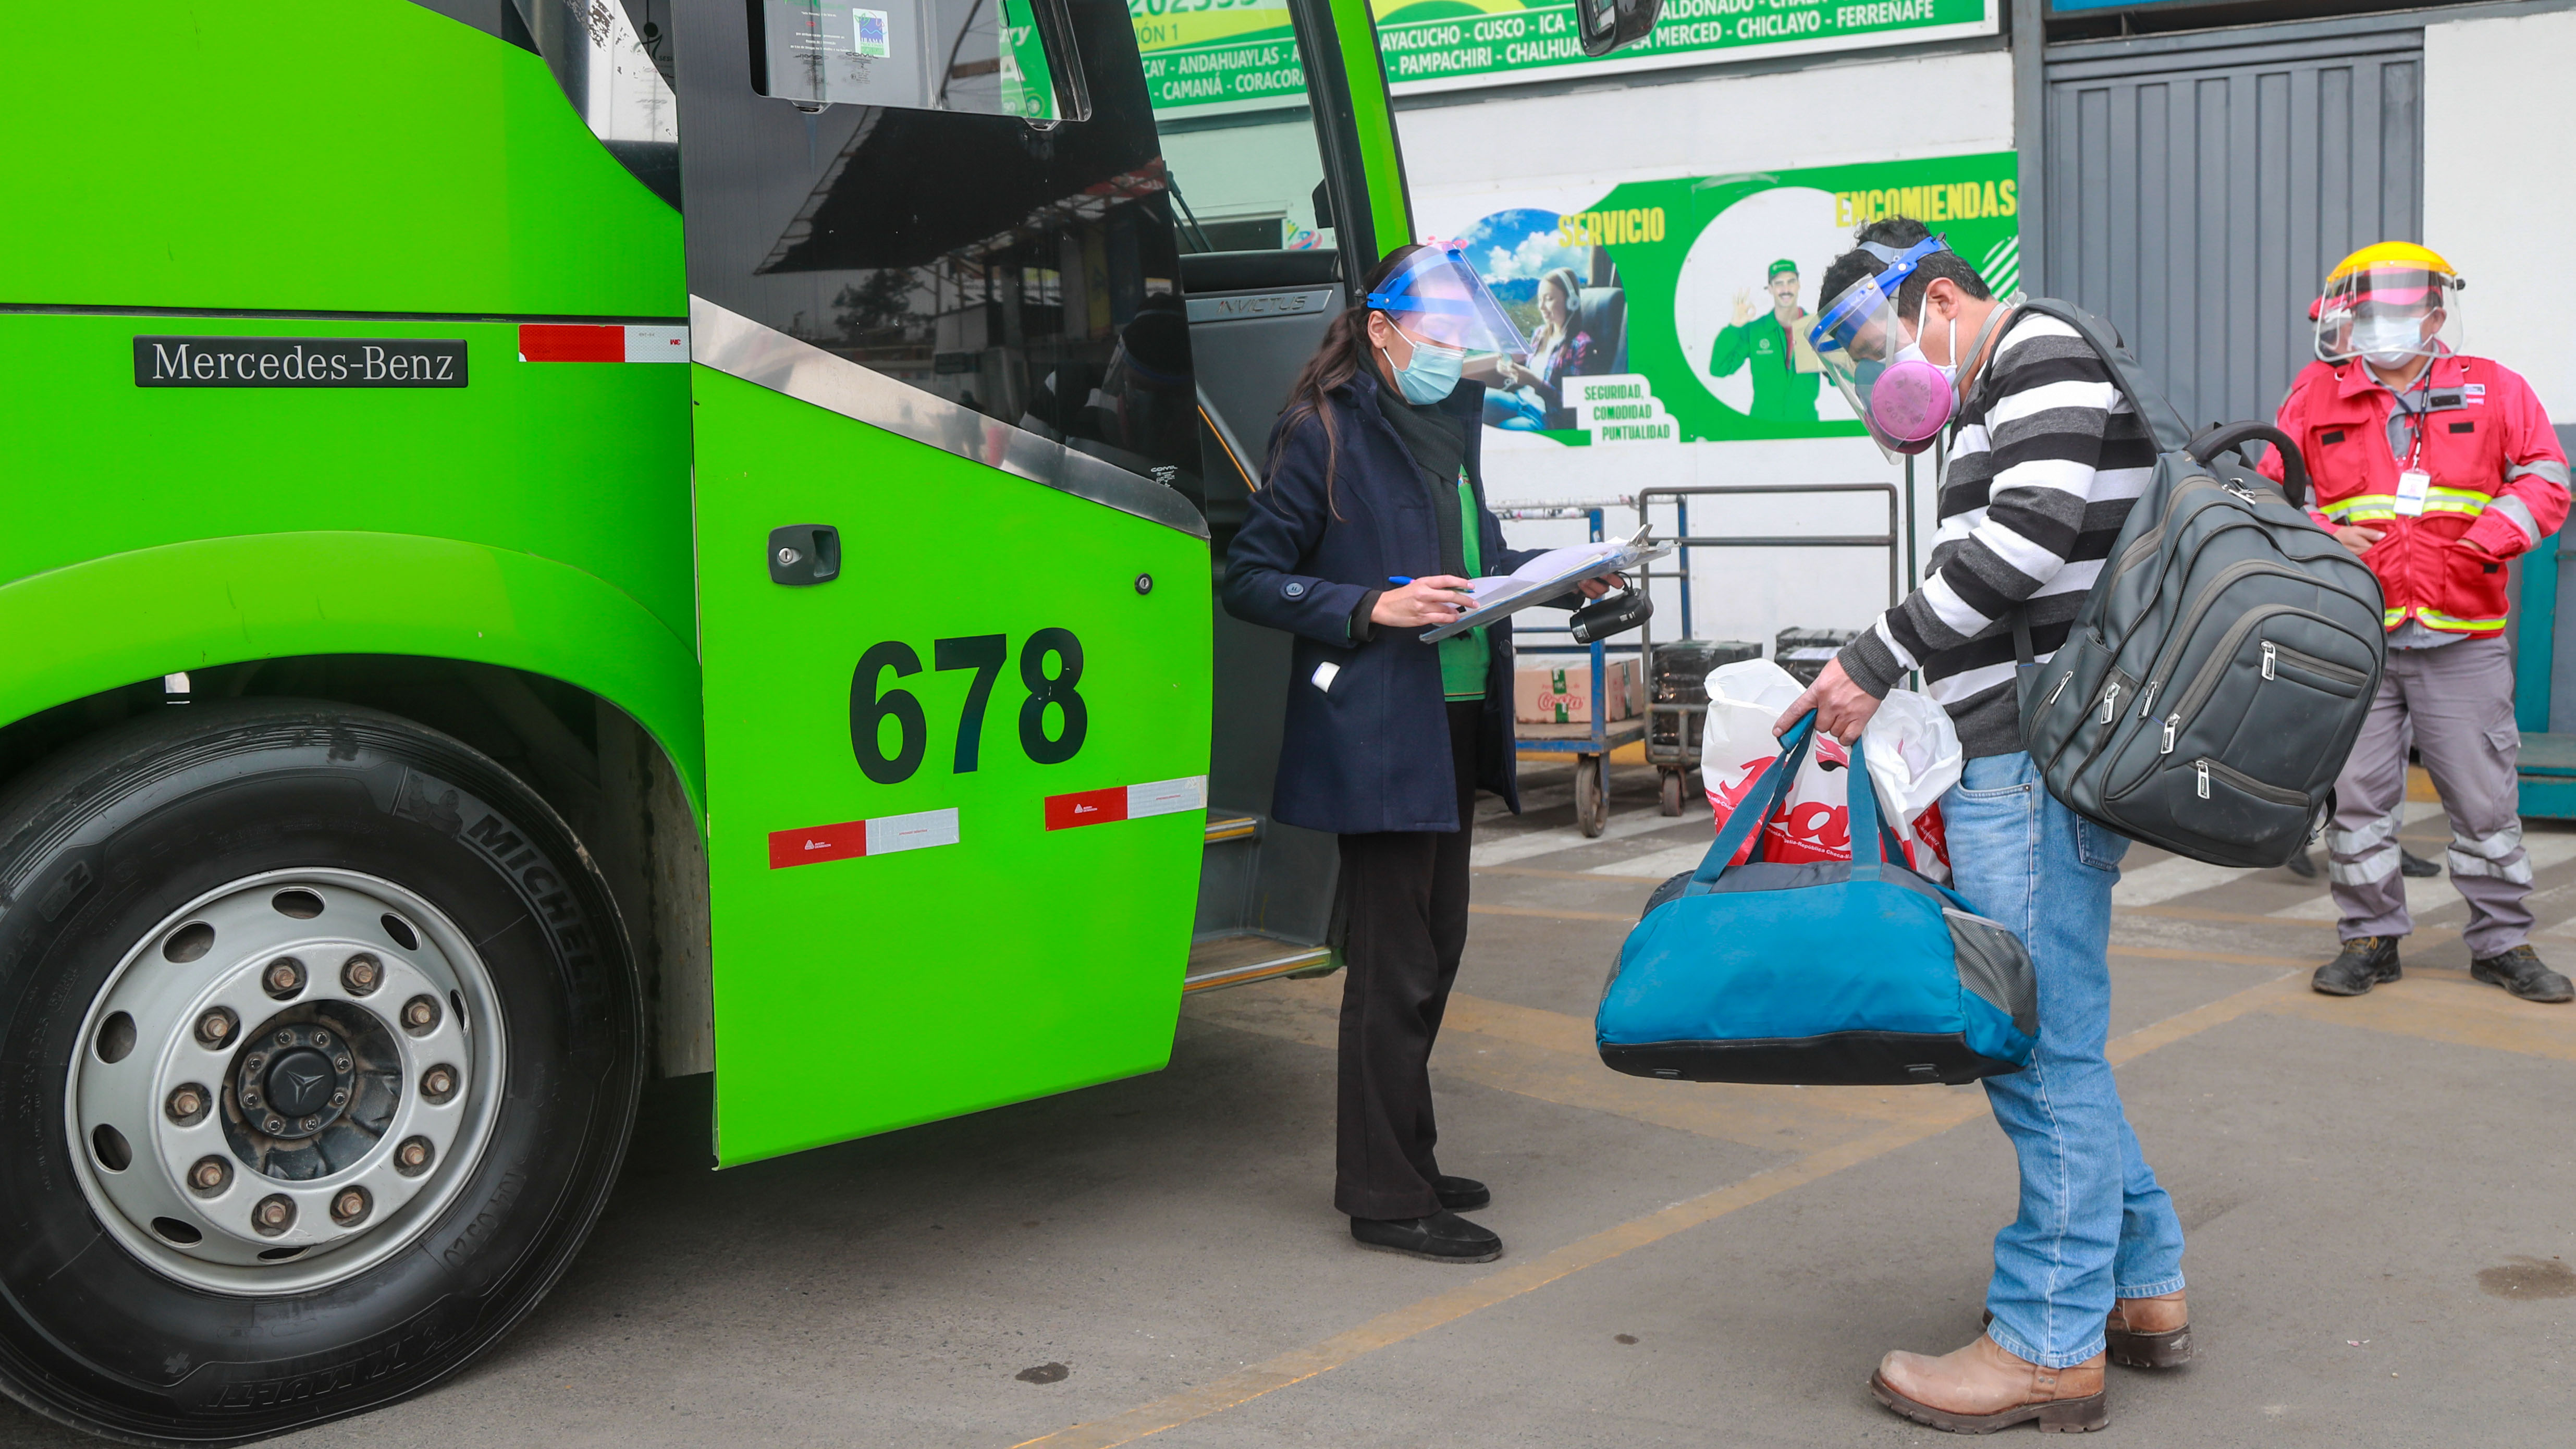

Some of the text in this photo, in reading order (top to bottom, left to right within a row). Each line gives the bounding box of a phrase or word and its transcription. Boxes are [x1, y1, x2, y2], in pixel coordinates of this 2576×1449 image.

[1172, 23, 1177, 40] 1
[1381, 25, 1460, 52] AYACUCHO
[1474, 17, 1525, 41] CUSCO
[1539, 13, 1566, 34] ICA
[1656, 21, 1721, 47] MERCED
[1737, 10, 1820, 39] CHICLAYO
[1179, 46, 1279, 75] ANDAHUAYLAS
[1400, 46, 1492, 76] PAMPACHIRI
[1506, 36, 1585, 63] CHALHUA
[1162, 71, 1223, 100] CAMANÁ
[1836, 179, 2016, 227] ENCOMIENDAS
[1558, 207, 1665, 248] SERVICIO
[1217, 295, 1307, 314] INVICTUS
[153, 343, 453, 382] Mercedes-Benz
[1585, 385, 1644, 401] SEGURIDAD,
[1593, 404, 1652, 421] COMODIDAD
[1602, 424, 1670, 441] PUNTUALIDAD
[849, 627, 1088, 784] 678
